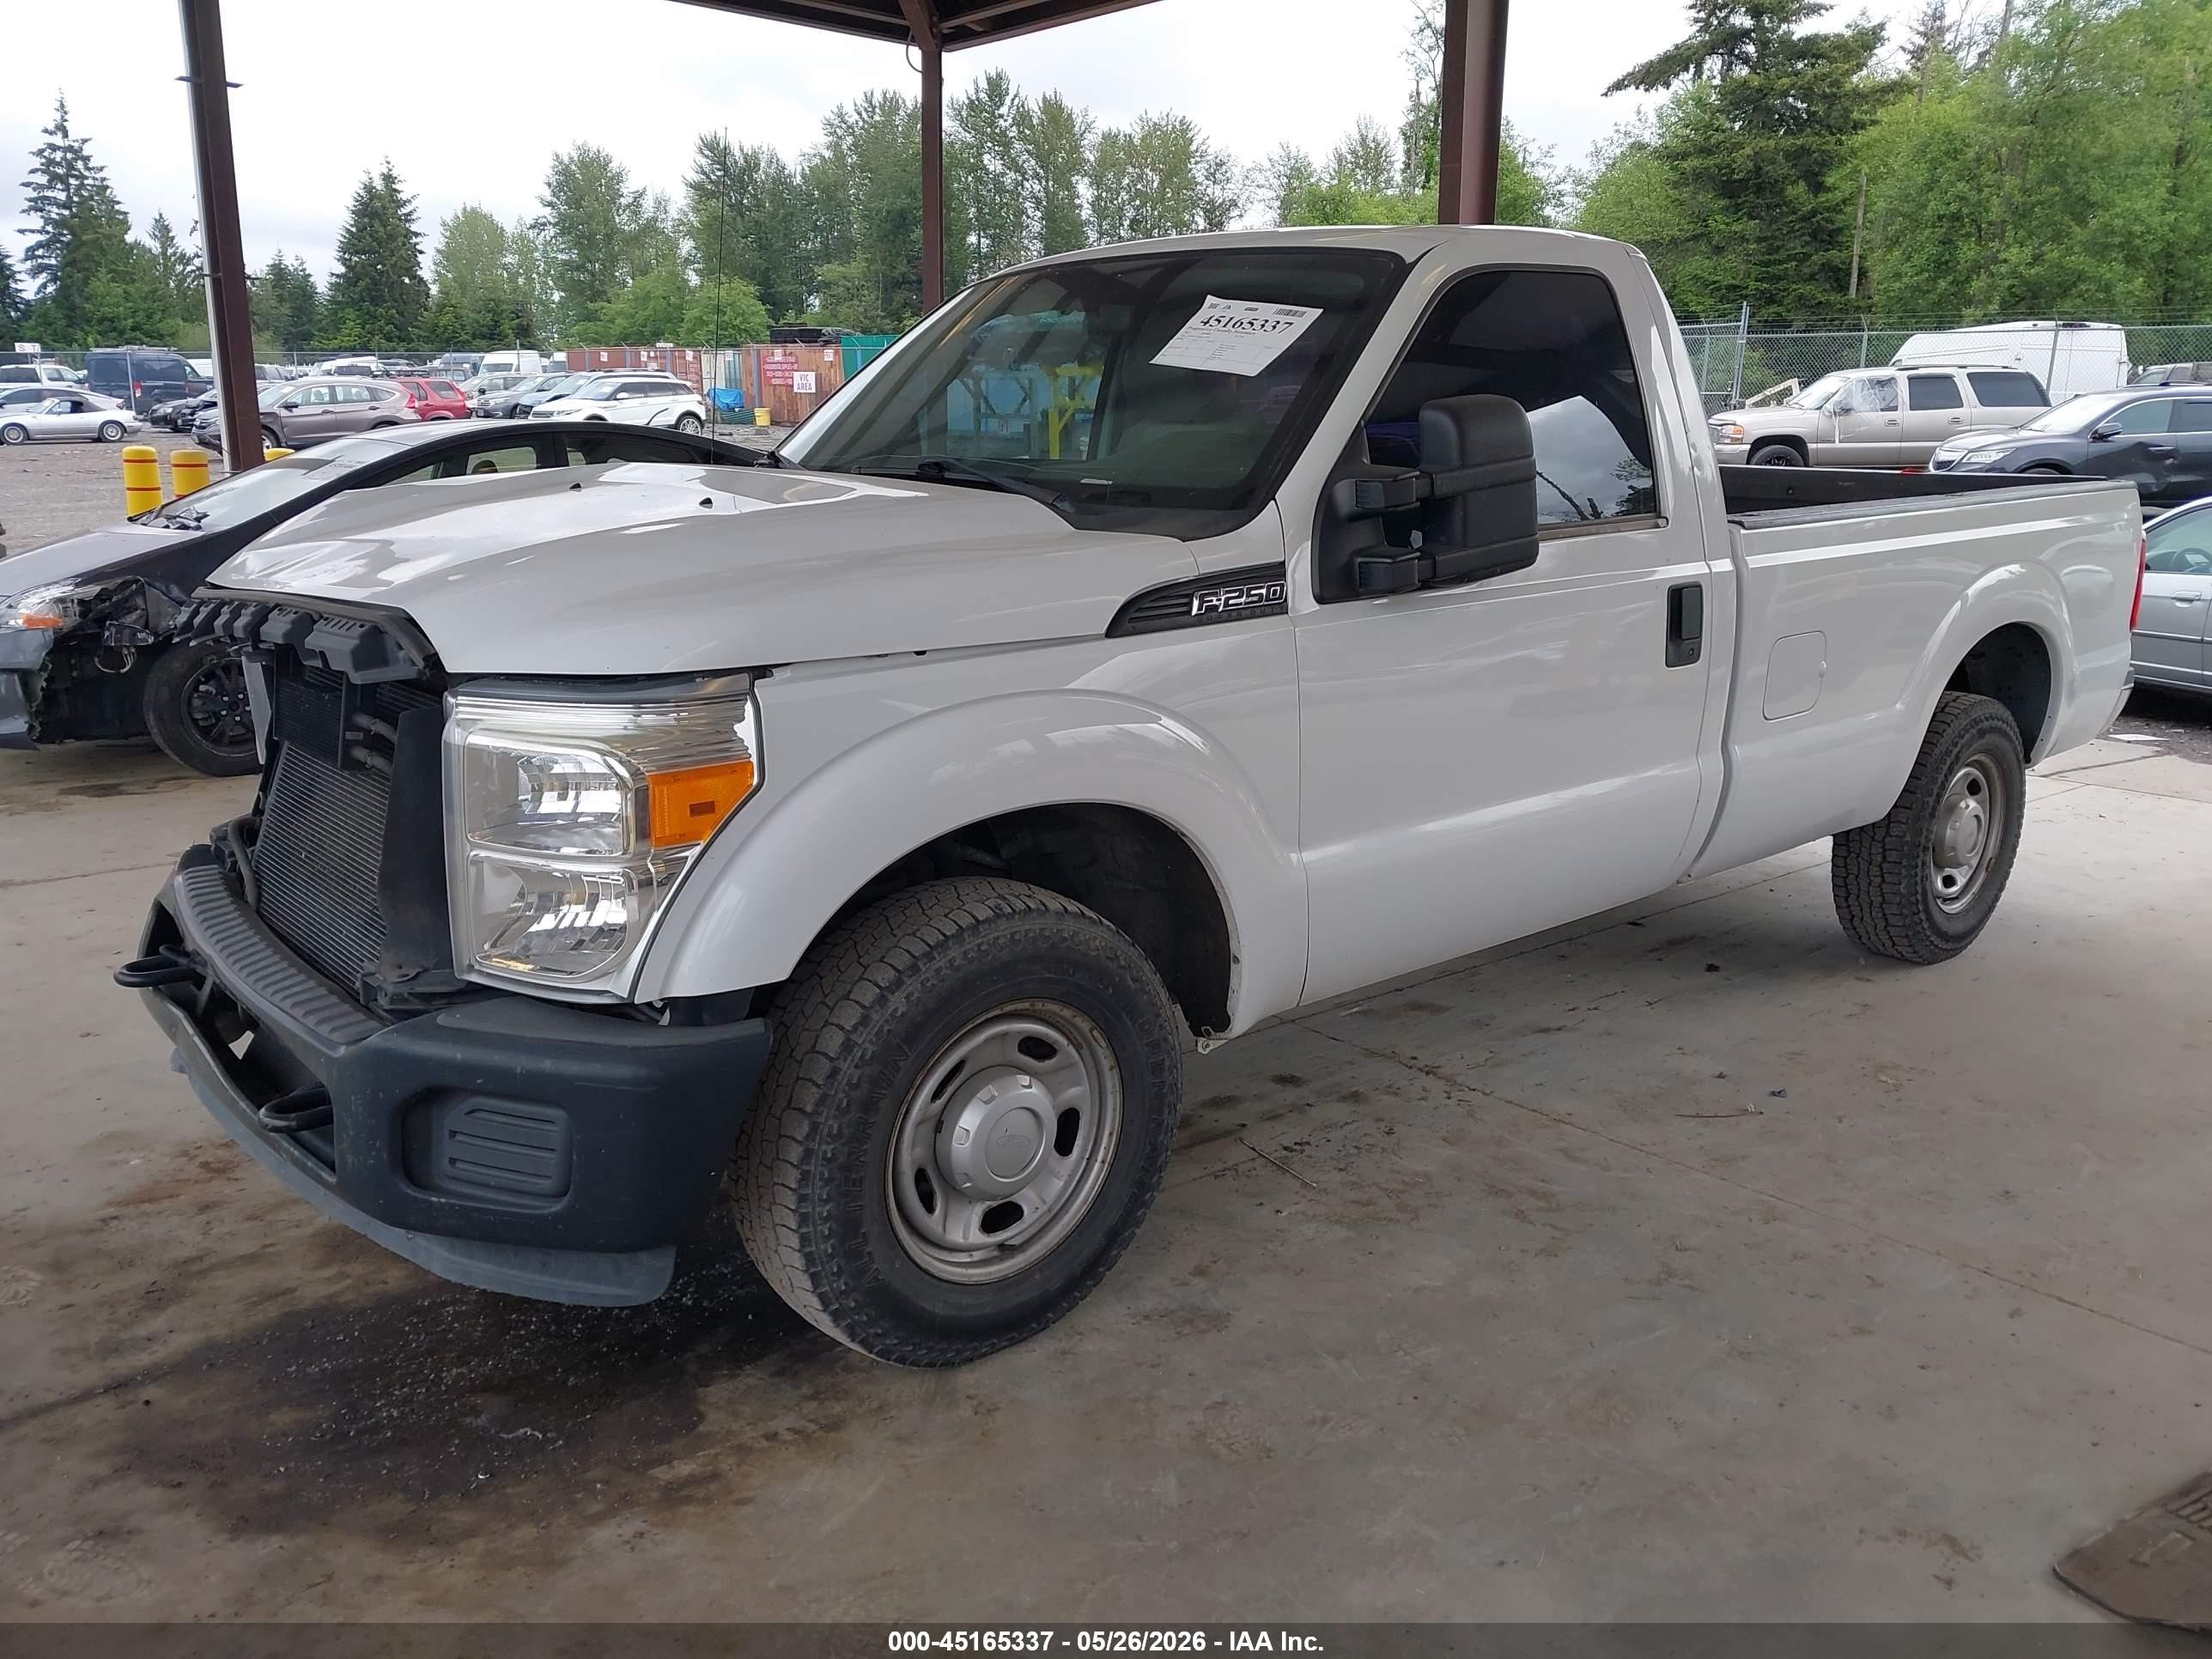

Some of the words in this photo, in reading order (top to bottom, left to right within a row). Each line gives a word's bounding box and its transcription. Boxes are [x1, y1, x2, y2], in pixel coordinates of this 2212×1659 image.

[1200, 314, 1295, 334] 45165337
[799, 374, 809, 382] VIC
[844, 1228, 888, 1291] ALL
